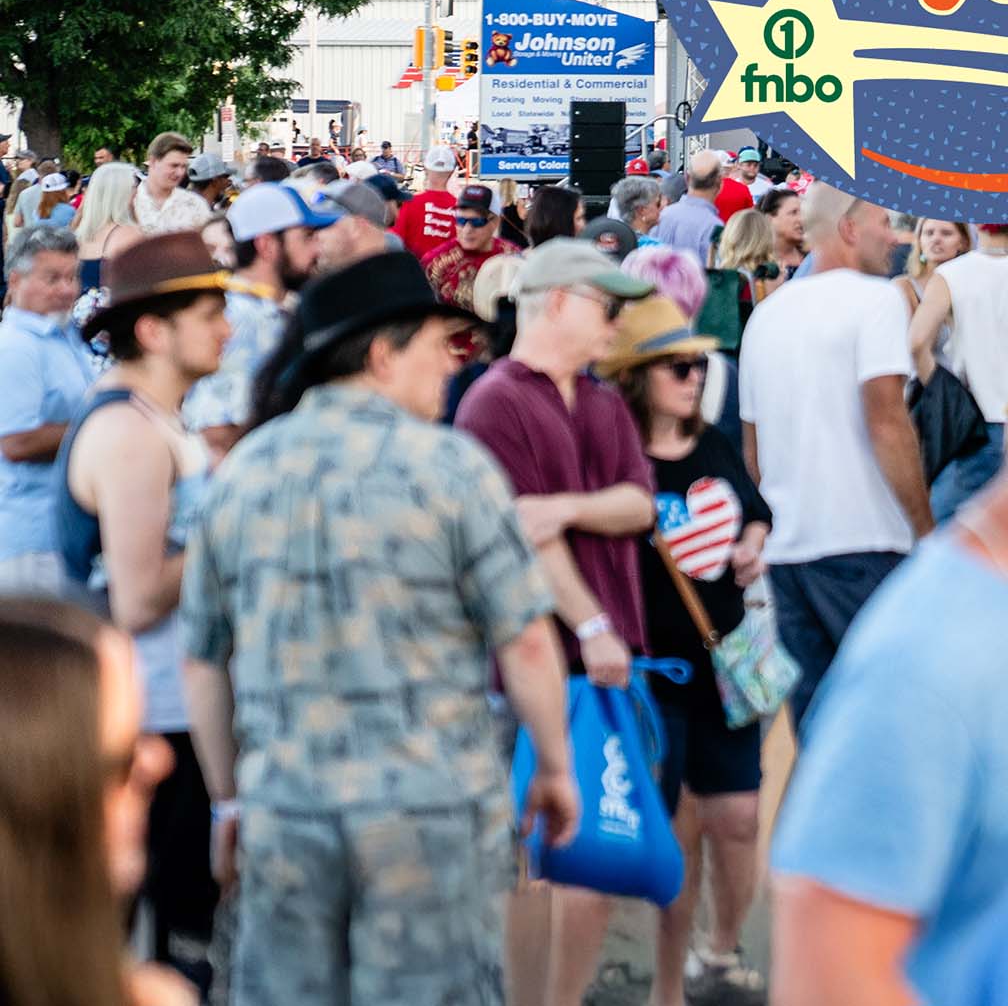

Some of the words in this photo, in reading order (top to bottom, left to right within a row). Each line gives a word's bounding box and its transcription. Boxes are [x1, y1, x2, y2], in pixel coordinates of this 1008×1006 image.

[485, 13, 618, 26] 1-800-BUY-MOVE
[515, 33, 616, 51] Johnson
[561, 52, 613, 67] United
[492, 79, 560, 89] Residential
[563, 79, 572, 89] &
[576, 79, 648, 89] Commercial
[491, 96, 526, 105] Packing
[532, 96, 563, 105] Moving
[518, 110, 554, 118] Statewide
[498, 159, 537, 171] Serving
